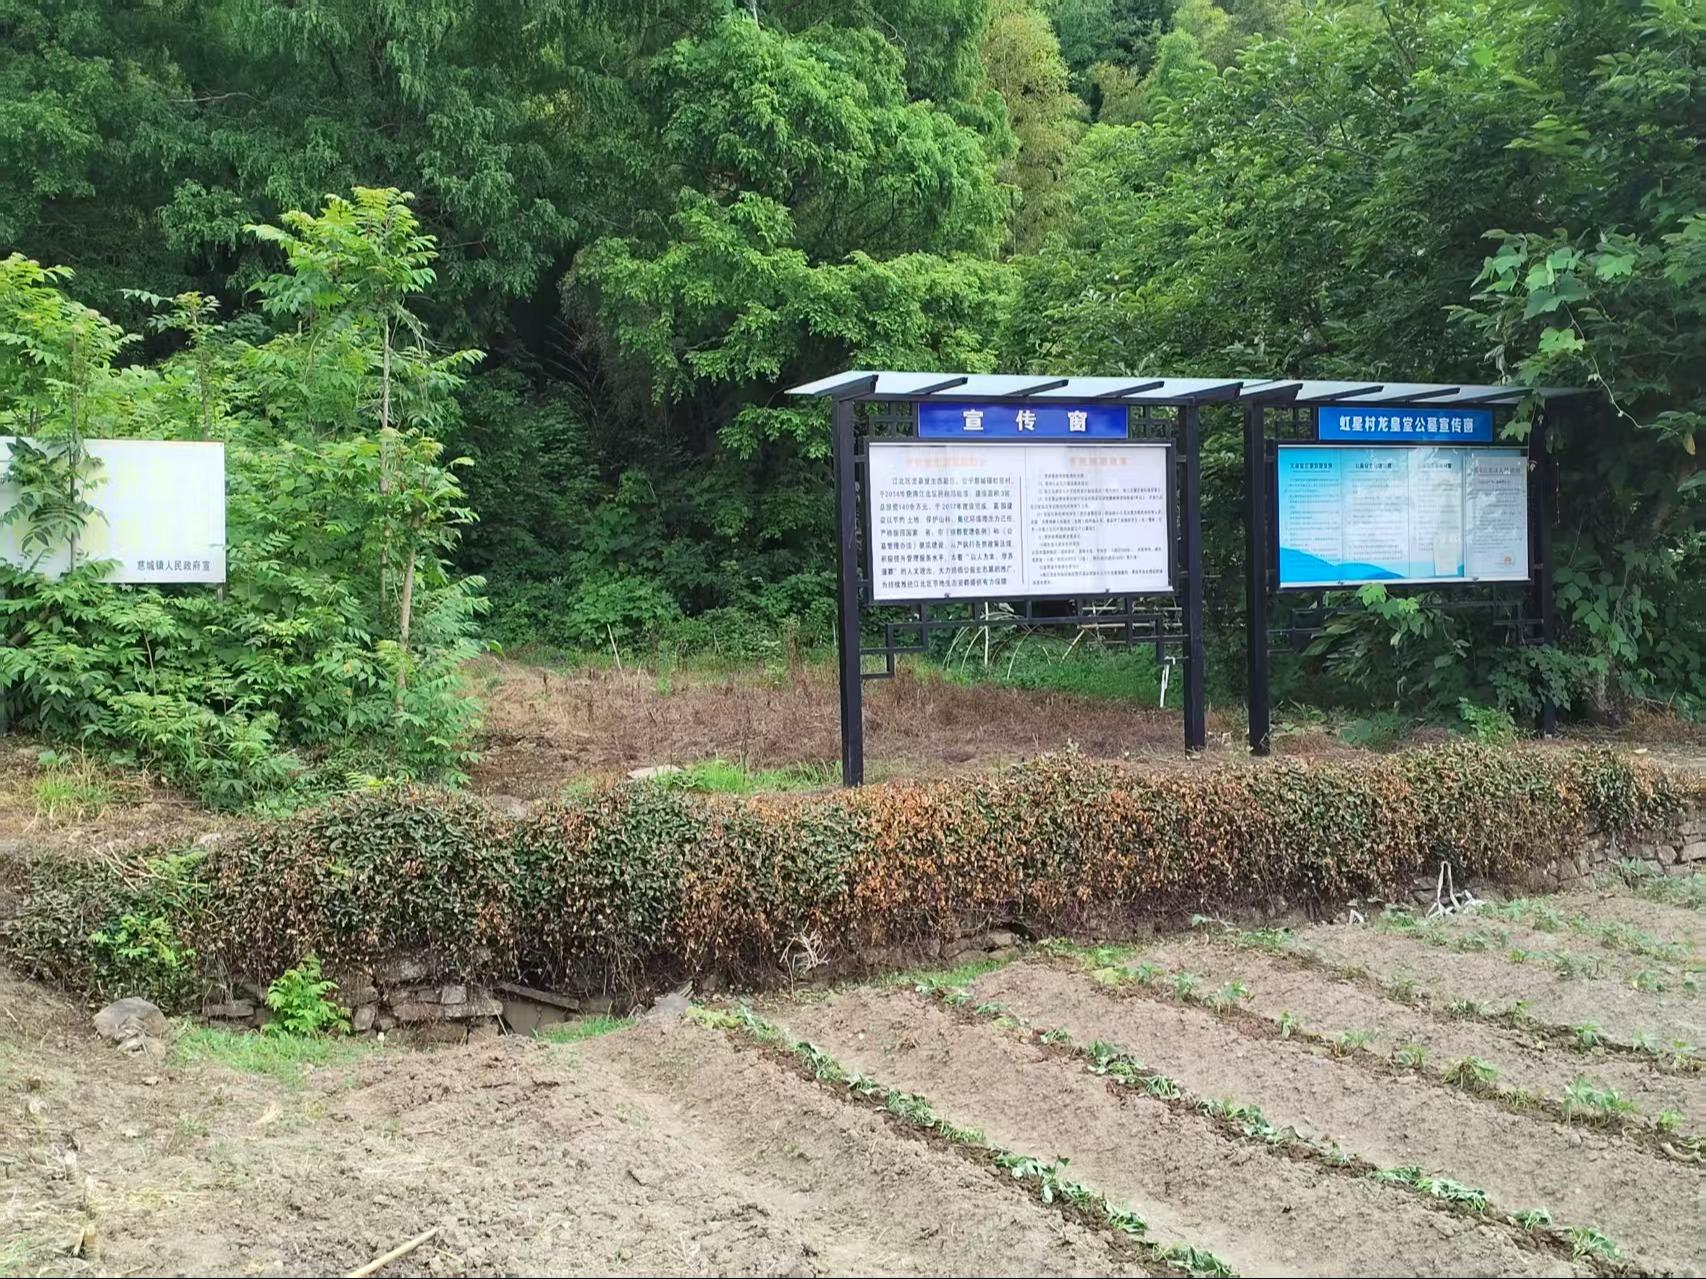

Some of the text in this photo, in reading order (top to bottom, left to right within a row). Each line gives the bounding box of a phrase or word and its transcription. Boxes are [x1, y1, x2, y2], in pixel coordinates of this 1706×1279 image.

[962, 409, 1088, 432] 宣传窗
[1339, 415, 1474, 433] 虹星村龙皇堂公墓宣传窗
[137, 560, 211, 572] 慈城镇人民政府宣
